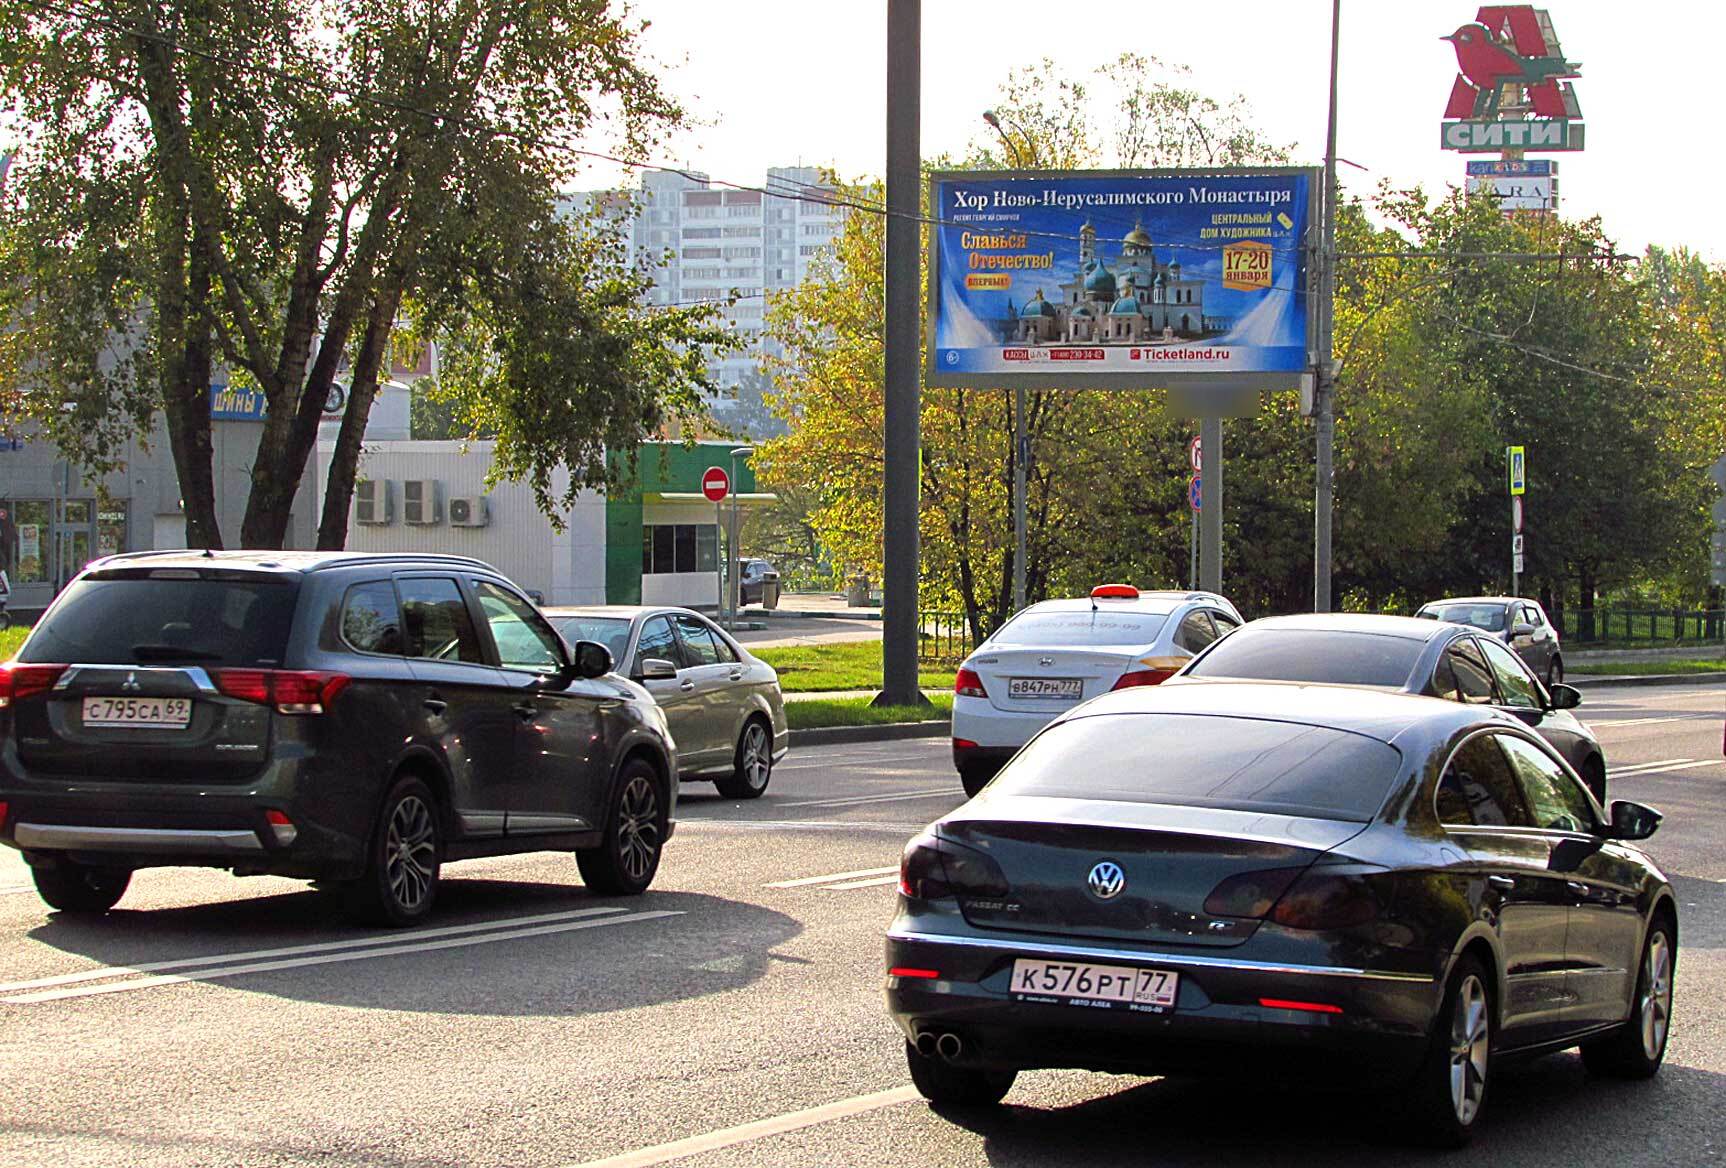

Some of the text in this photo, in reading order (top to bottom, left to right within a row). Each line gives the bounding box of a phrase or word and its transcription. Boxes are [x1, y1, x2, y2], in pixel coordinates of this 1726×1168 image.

[1446, 122, 1562, 145] СИТИ
[954, 187, 1291, 211] Хор Ново-Иерусалимского Монастыря
[1211, 212, 1273, 225] ЦЕНТРАЛЬНЫЙ
[961, 231, 1027, 249] Славься
[1200, 227, 1218, 239] ДОМ
[1220, 227, 1272, 239] ХУДОЖНИКА
[968, 251, 1054, 270] Отечество!
[1226, 251, 1269, 270] 17-20
[1226, 270, 1269, 283] января
[1143, 349, 1230, 361] Ticketland.ru
[213, 392, 256, 413] ШИНЫ
[166, 699, 184, 715] 69
[1022, 964, 1169, 997] К576РТ 77
[1136, 992, 1157, 1002] RUS
